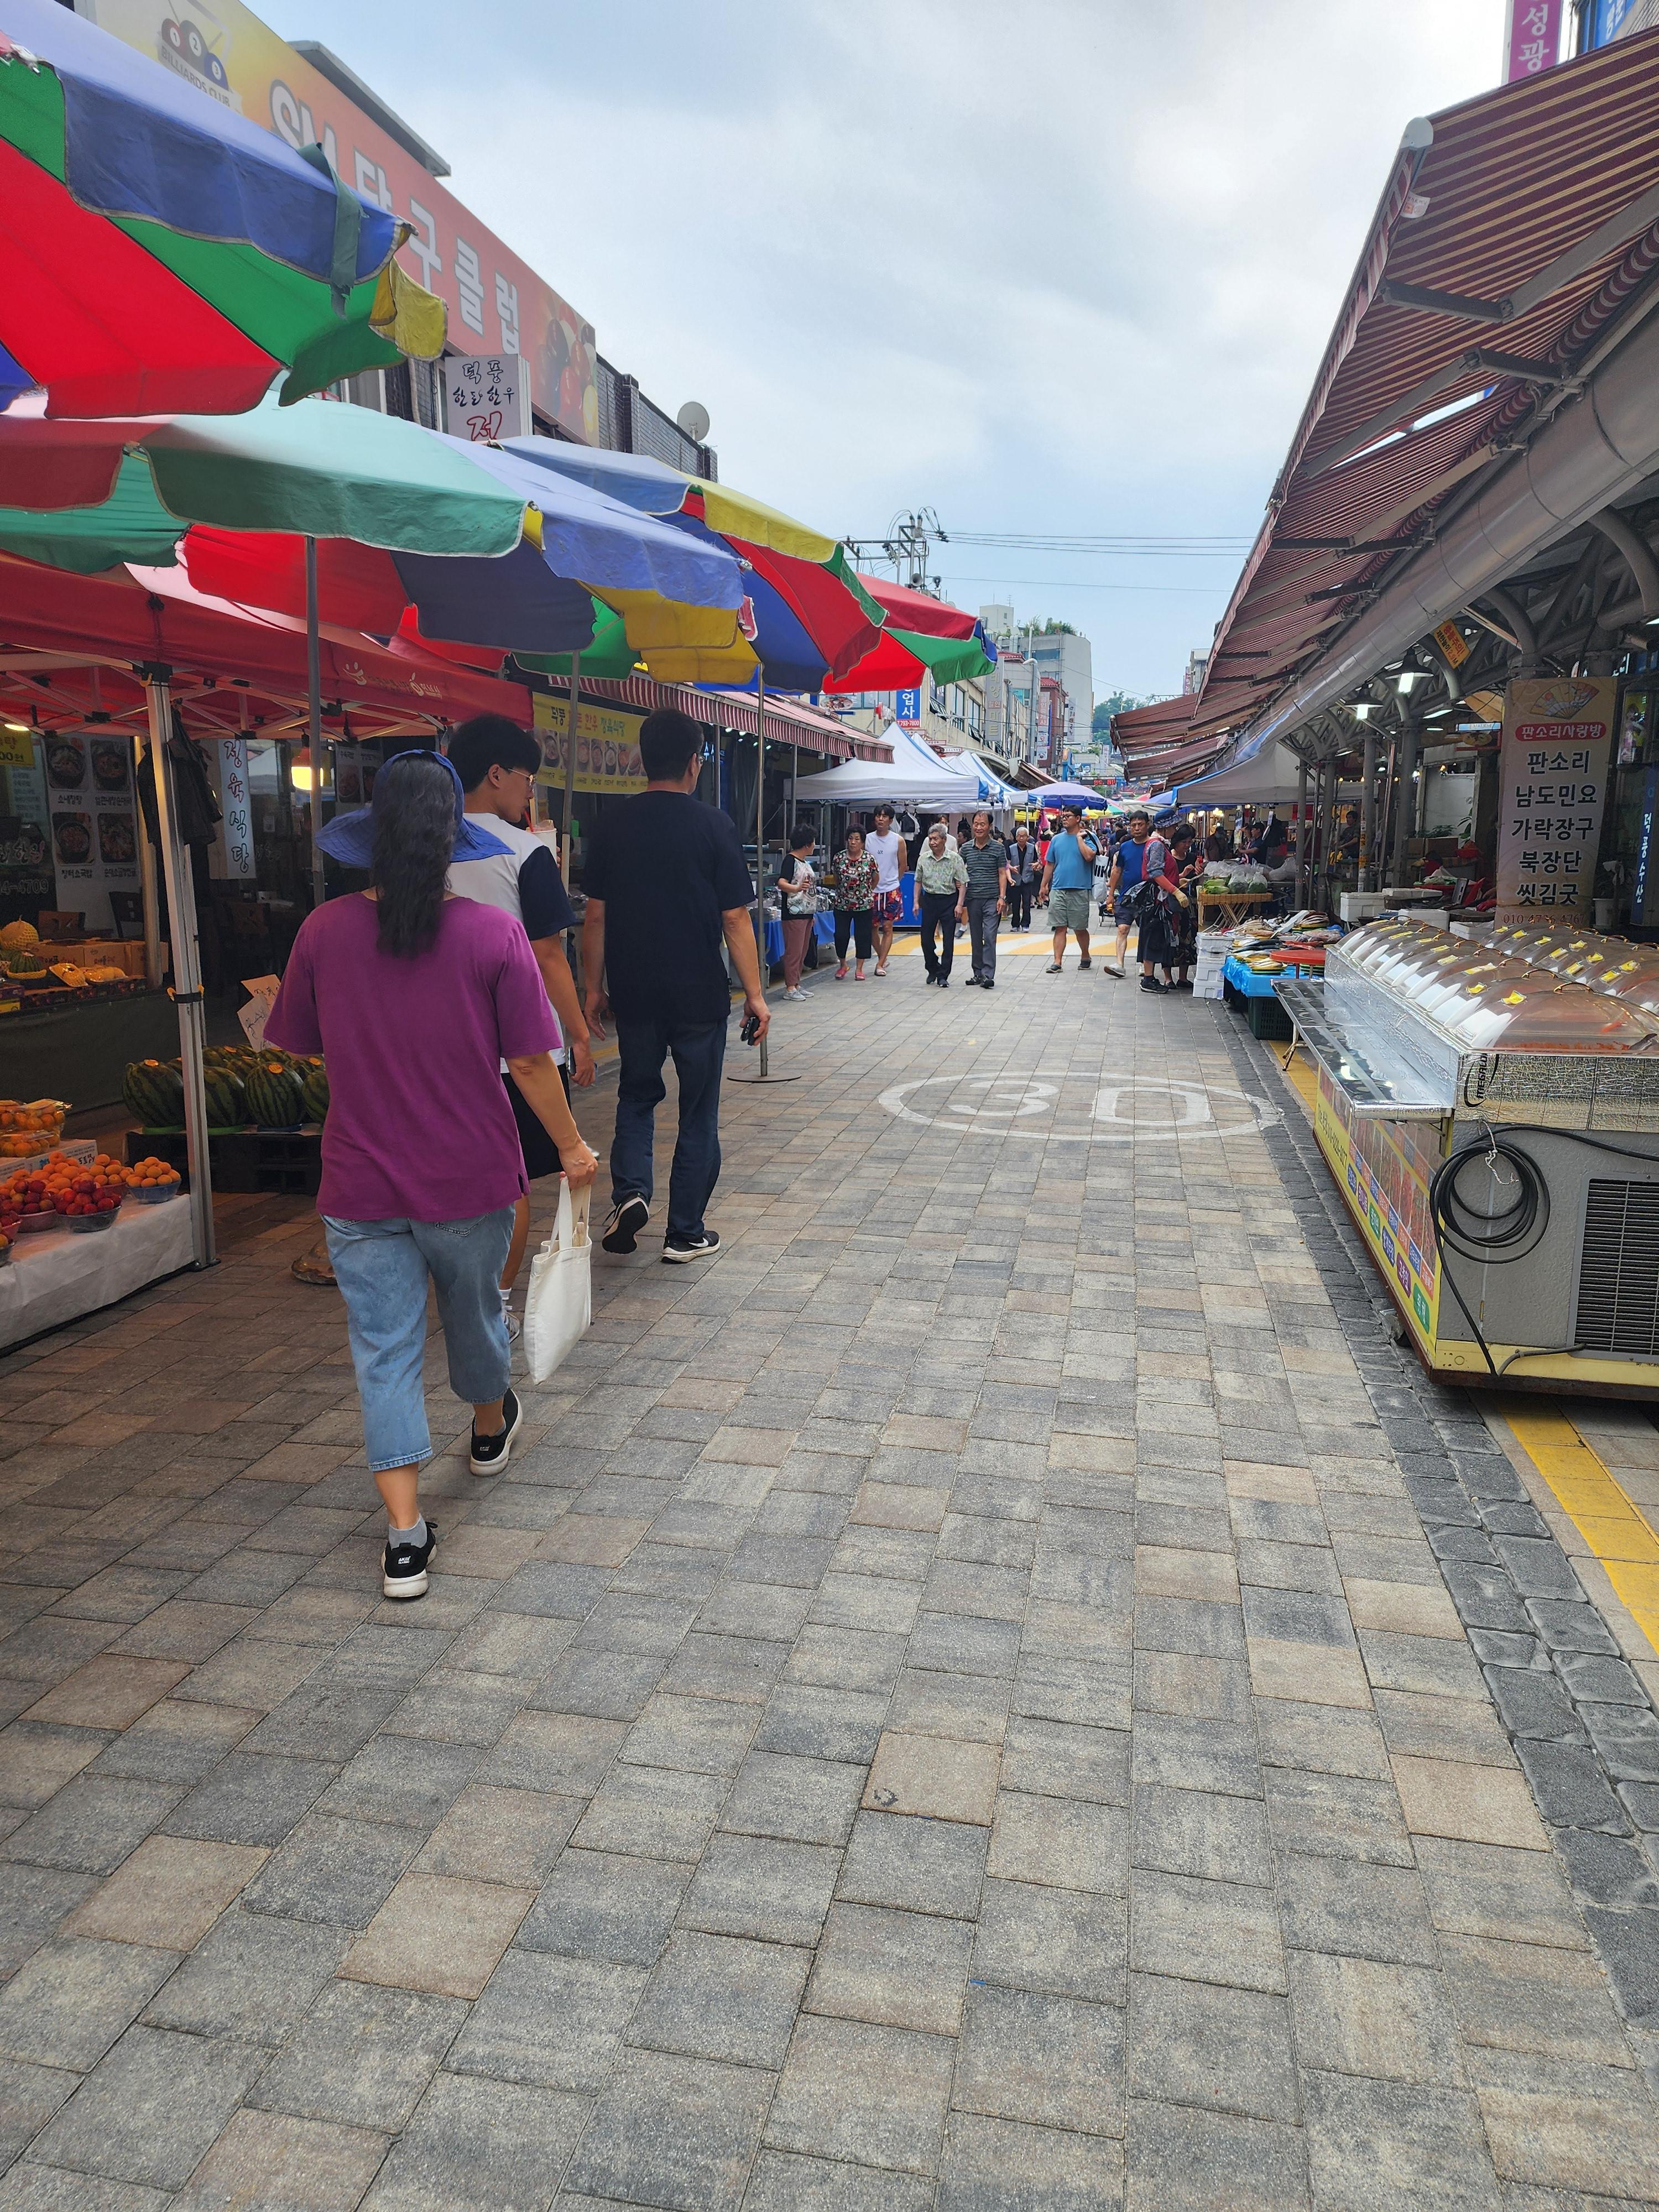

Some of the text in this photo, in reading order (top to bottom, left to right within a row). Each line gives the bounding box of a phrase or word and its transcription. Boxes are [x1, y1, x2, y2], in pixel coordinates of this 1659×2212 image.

[1517, 0, 1550, 72] 성광
[161, 45, 208, 94] BILLIARDS
[462, 359, 504, 384] 덕풍
[487, 385, 515, 406] 한우
[901, 689, 915, 719] 업사
[551, 706, 566, 727] 덕풍
[584, 713, 598, 732] 한우
[600, 716, 625, 737] 정육식당
[1521, 724, 1602, 739] 판소리사랑방
[1526, 750, 1590, 775] 판소리
[223, 739, 249, 874] 정육식당
[1515, 784, 1598, 808] 남도민요
[1511, 817, 1594, 841] 가락장구
[1519, 850, 1583, 874] 북장단
[1516, 883, 1580, 906] 씻김굿
[1503, 914, 1524, 924] 010
[947, 1079, 1213, 1126] 30
